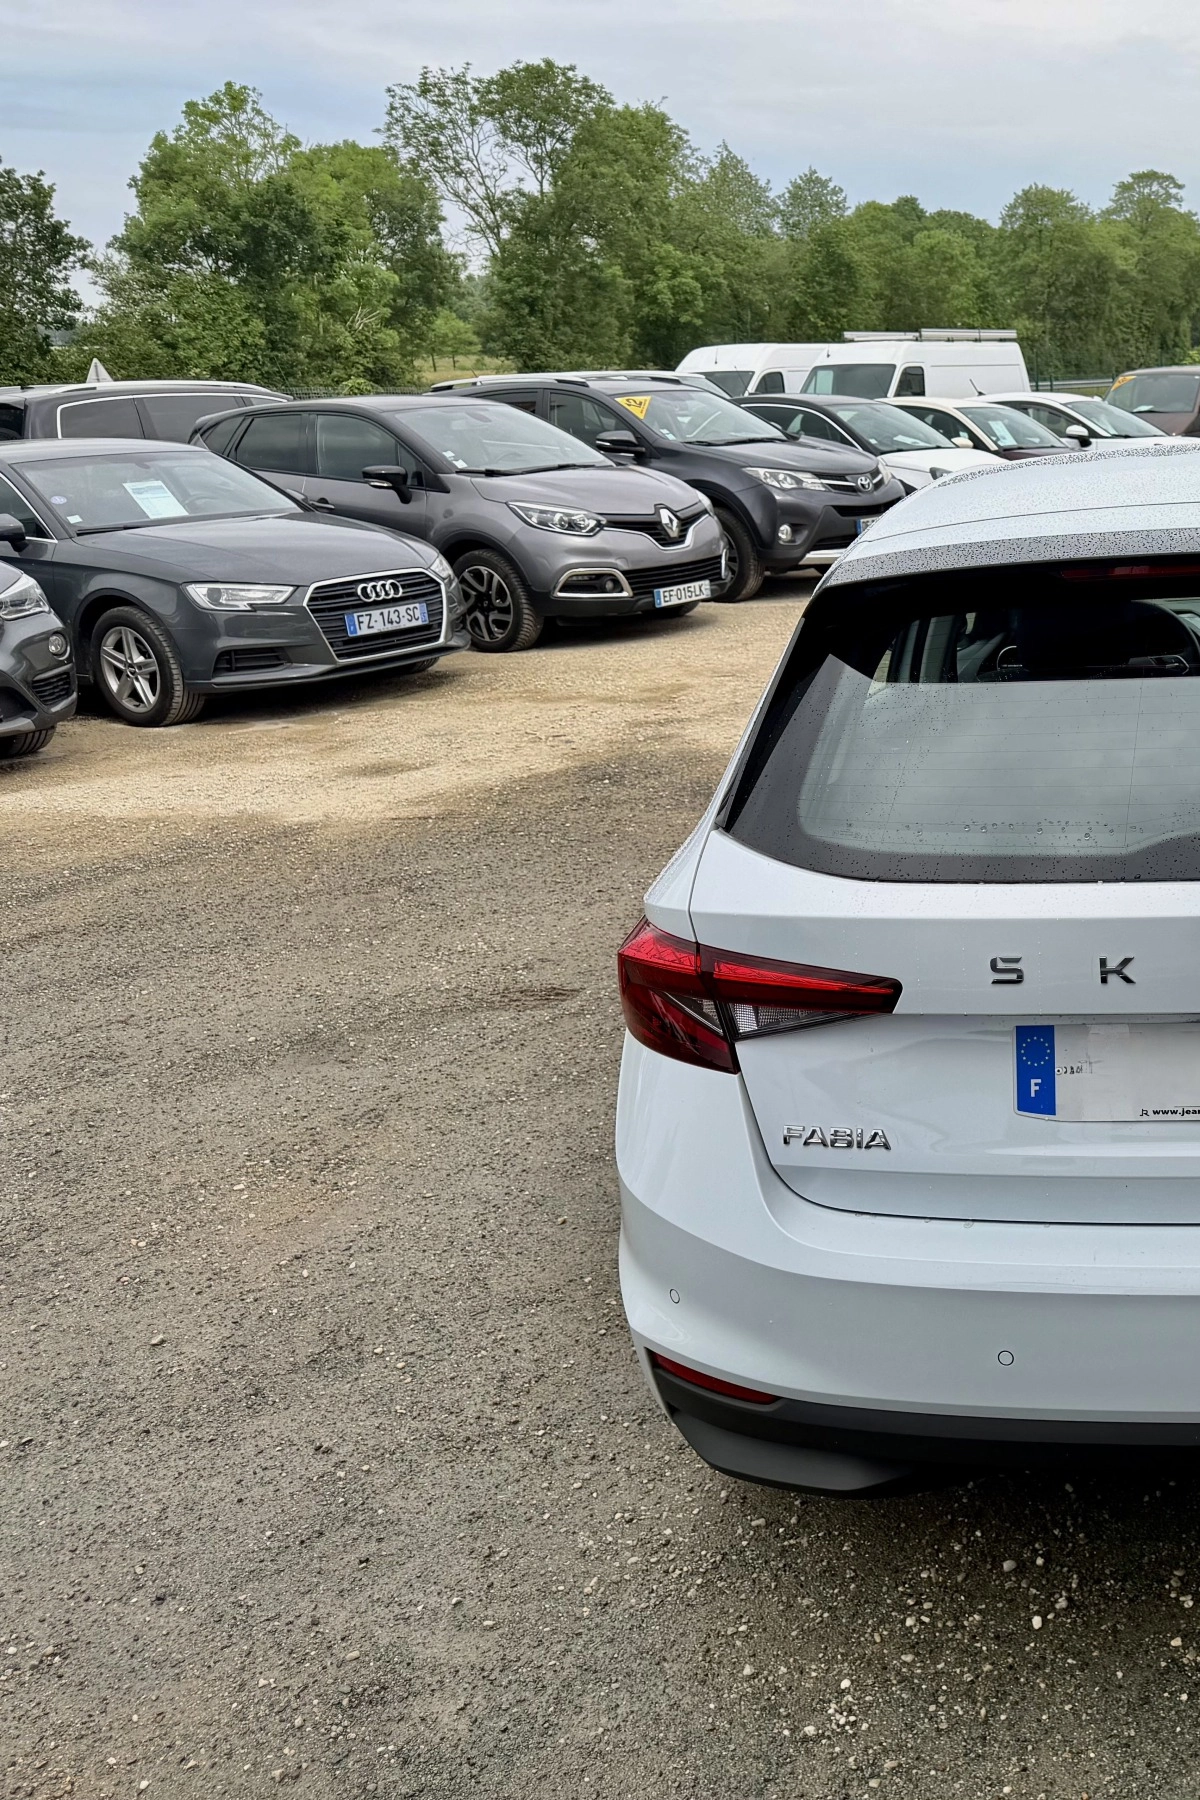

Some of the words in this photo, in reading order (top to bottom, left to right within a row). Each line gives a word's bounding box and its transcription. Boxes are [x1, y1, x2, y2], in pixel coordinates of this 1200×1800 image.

[356, 606, 420, 631] FZ-143-SC
[1030, 1078, 1042, 1098] F
[783, 1125, 891, 1150] FABIA
